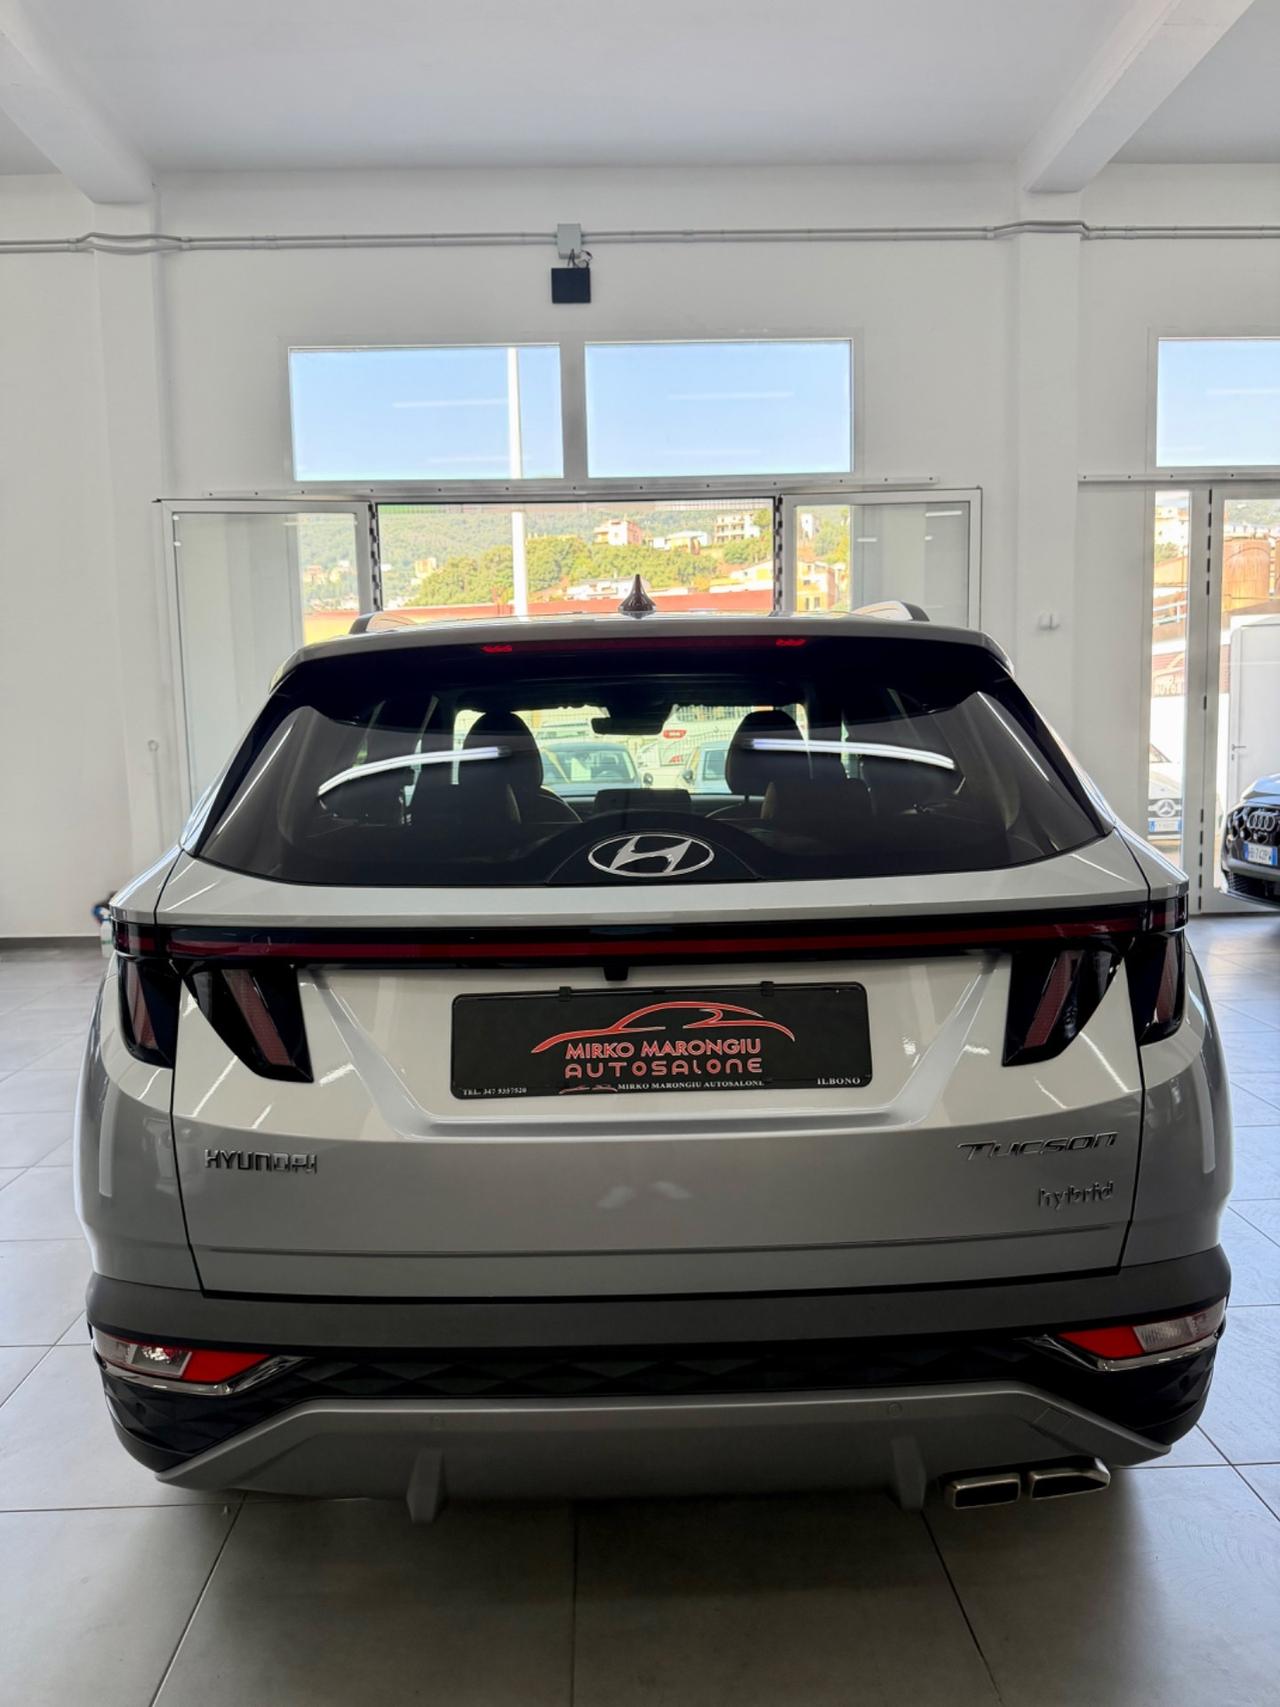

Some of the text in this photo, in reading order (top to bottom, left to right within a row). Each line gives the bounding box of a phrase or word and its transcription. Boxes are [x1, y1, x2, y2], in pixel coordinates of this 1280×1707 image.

[565, 1038, 761, 1060] MIRKO MARONGIU
[564, 1057, 763, 1079] AUTOSALONE
[651, 1081, 702, 1089] MARONGIU
[816, 1077, 861, 1085] ILBONO
[957, 1131, 1119, 1161] TUCSON
[204, 1148, 318, 1175] HYUNDAI
[1037, 1180, 1115, 1211] hybrid
